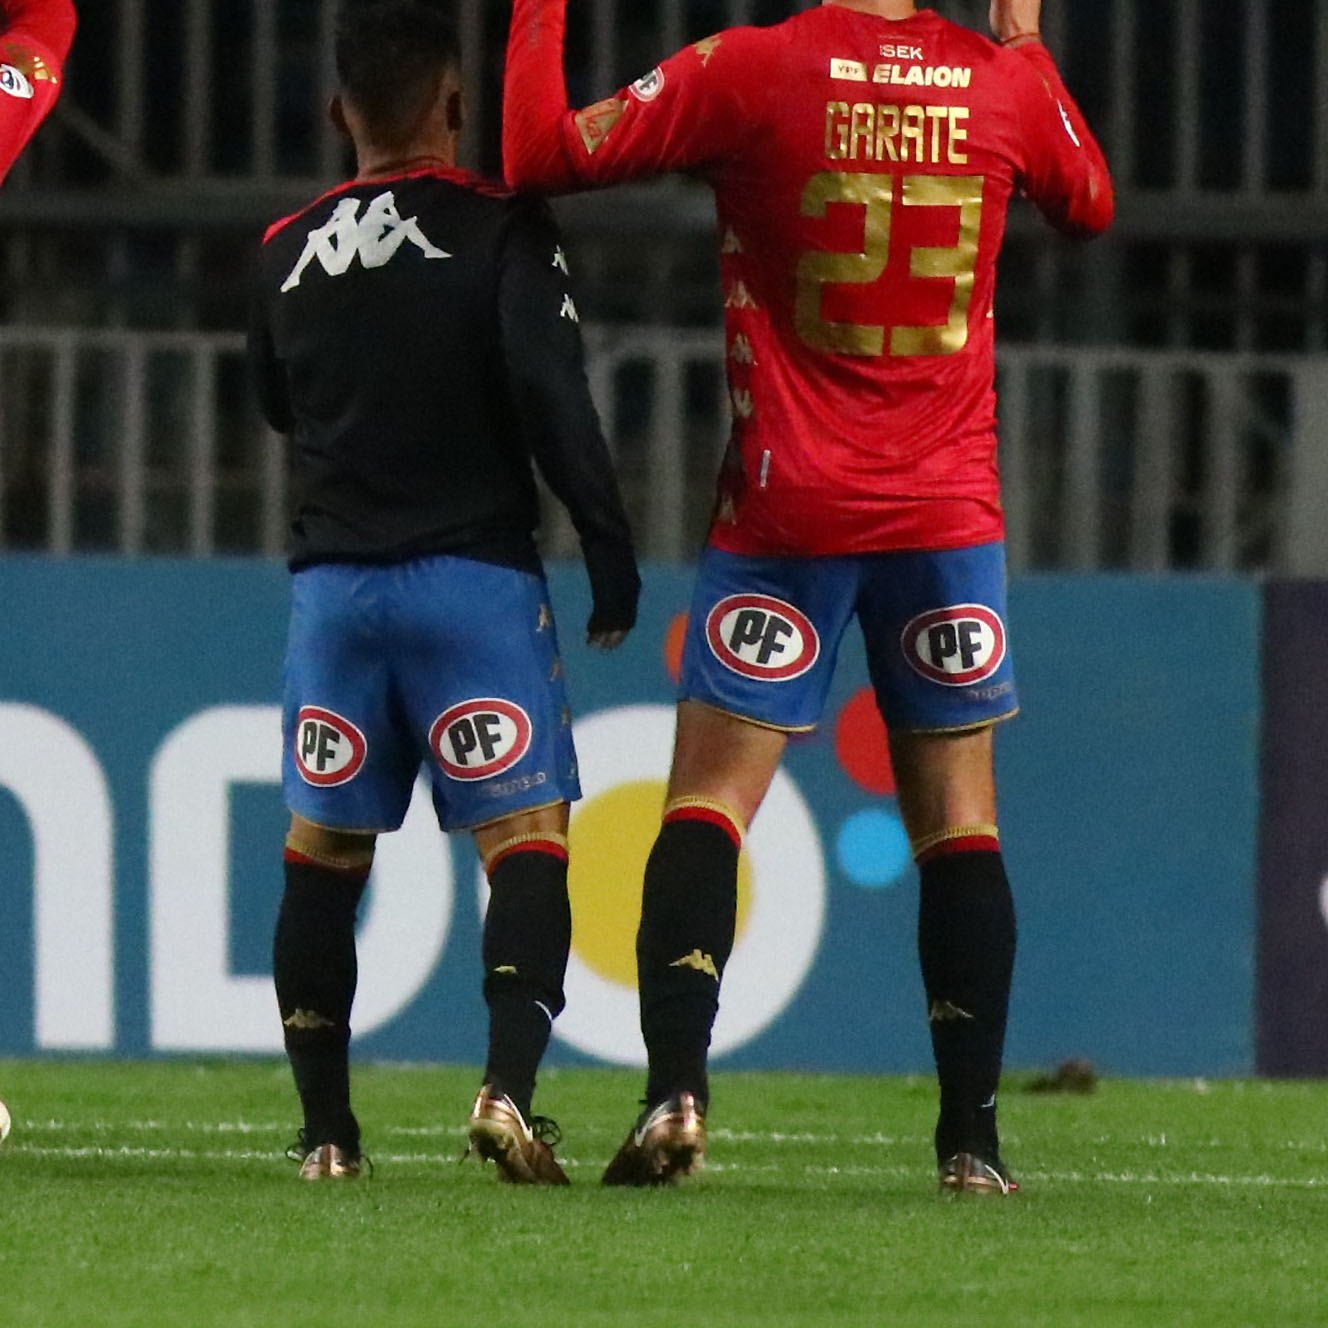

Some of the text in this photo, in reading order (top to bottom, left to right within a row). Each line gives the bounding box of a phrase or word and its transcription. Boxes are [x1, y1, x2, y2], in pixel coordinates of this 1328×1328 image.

[872, 63, 972, 88] ELAION
[825, 100, 970, 165] GARATE
[794, 172, 985, 357] 23
[729, 609, 794, 665] PF
[928, 620, 985, 669] PF
[302, 720, 340, 772] PF
[448, 713, 502, 765] PF
